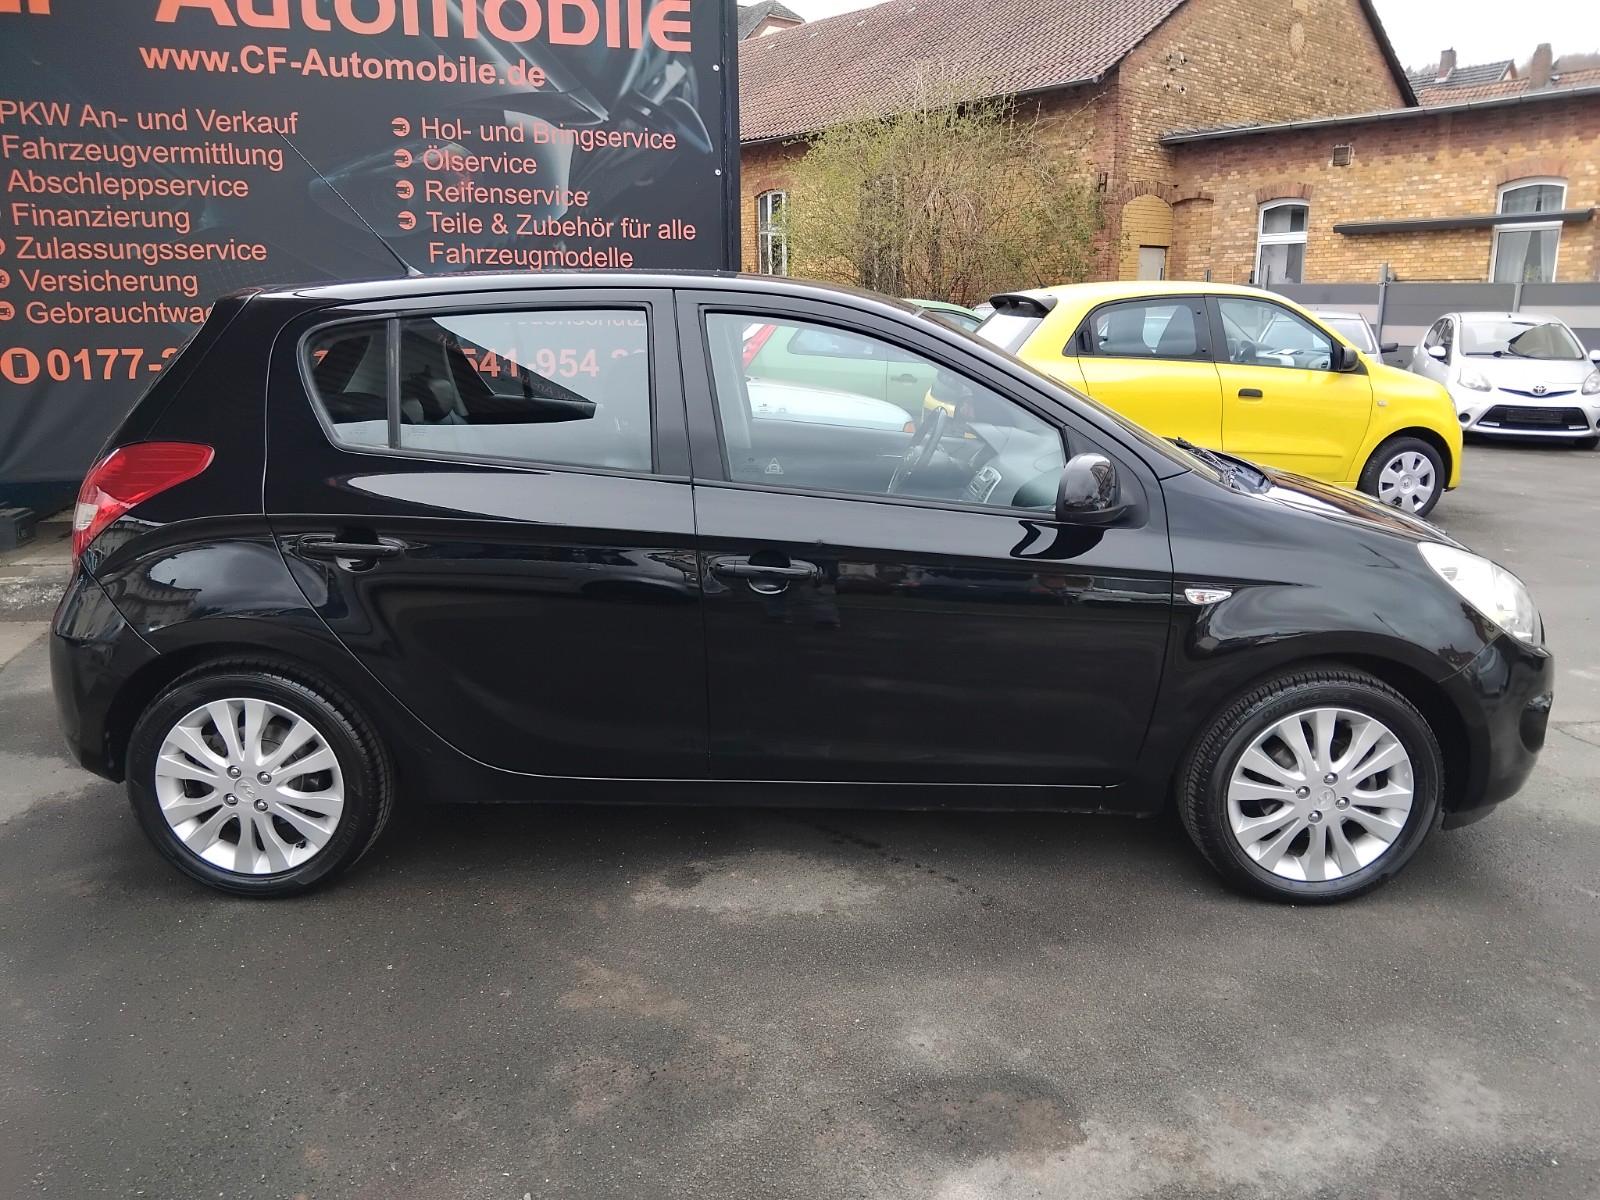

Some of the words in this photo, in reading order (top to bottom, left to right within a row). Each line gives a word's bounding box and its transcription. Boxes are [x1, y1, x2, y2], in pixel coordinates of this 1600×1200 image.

[138, 45, 546, 87] www.CF-Automobile.de
[0, 99, 70, 126] PKW
[79, 103, 129, 129] An-
[137, 109, 188, 131] und
[196, 108, 299, 135] Verkauf
[421, 117, 472, 141] Hol-
[480, 122, 525, 143] und
[533, 122, 678, 152] Bringservice
[1, 135, 285, 172] Fahrzeugvermittlung
[422, 145, 538, 175] Ölservice
[7, 169, 250, 201] Abschleppservice
[425, 180, 589, 207] Reifenservice
[11, 202, 191, 234] Finanzierung
[426, 210, 483, 234] Teile
[491, 213, 509, 235] &
[516, 213, 614, 238] Zubehör
[620, 217, 652, 240] für
[657, 218, 697, 241] alle
[15, 236, 268, 266] Zulassungsservice
[428, 241, 634, 271] Fahrzeugmodelle
[19, 269, 199, 298] Versicherung
[26, 300, 213, 325] Gebrauchtwa
